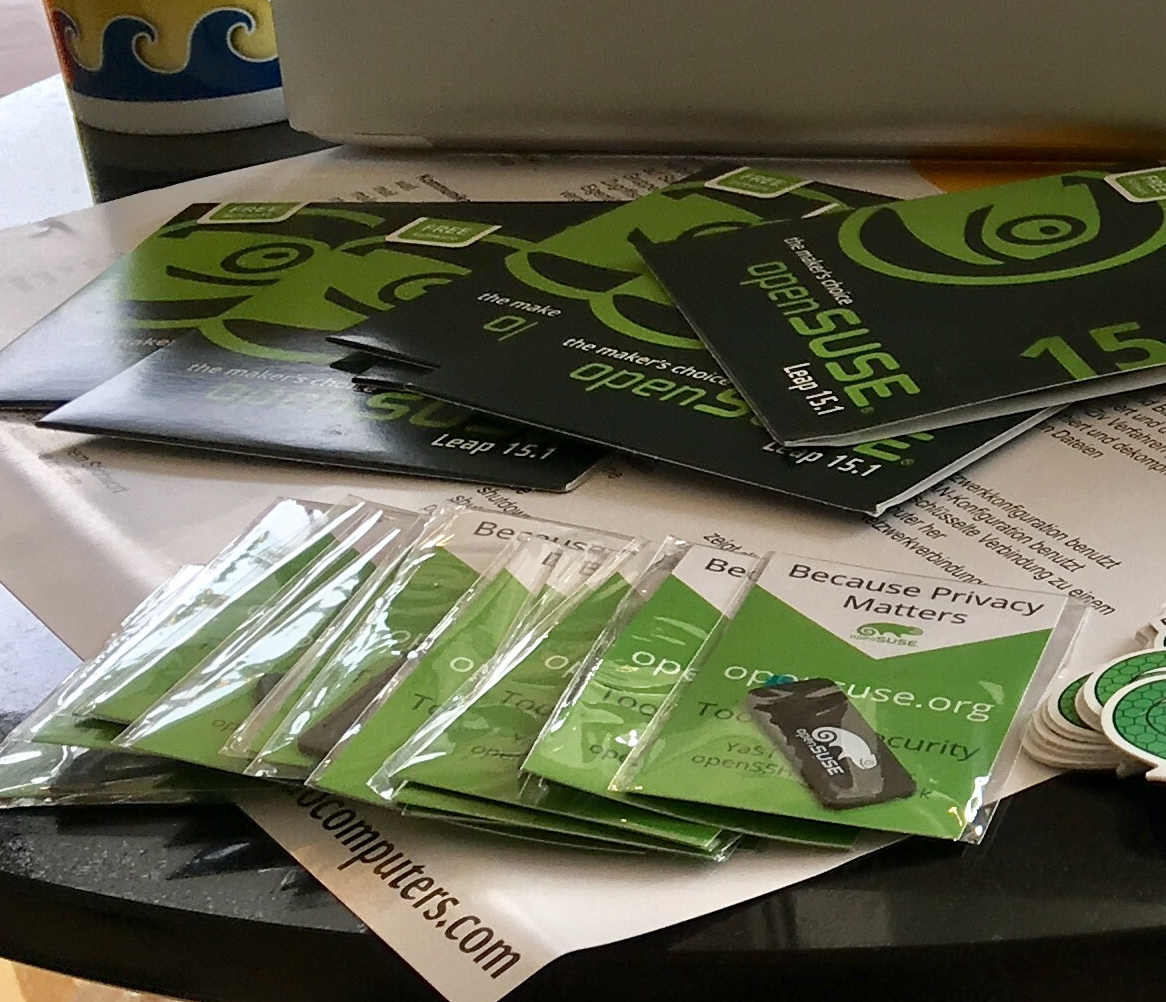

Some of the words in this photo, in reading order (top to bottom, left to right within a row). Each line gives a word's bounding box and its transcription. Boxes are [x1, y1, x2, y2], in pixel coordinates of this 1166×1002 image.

[421, 223, 474, 236] FREE
[478, 292, 511, 306] the
[508, 298, 562, 318] make
[740, 261, 920, 408] openSUSE
[186, 361, 222, 376] the
[562, 336, 597, 352] the
[595, 344, 671, 371] maker's
[783, 362, 819, 391] Leap
[805, 390, 845, 416] 15.1
[1132, 413, 1166, 428] und
[431, 433, 495, 455] Leap
[501, 442, 556, 460] 15.1
[1051, 429, 1104, 459] Dateien
[1087, 428, 1120, 445] und
[827, 454, 882, 478] 15.1
[917, 521, 948, 541] her
[950, 474, 1069, 543] zwerkkonfiguration
[1065, 537, 1123, 571] benutzt
[978, 532, 1054, 582] Verbindung
[1047, 575, 1073, 596] zu
[1029, 541, 1087, 574] benutzt
[788, 563, 922, 599] Because
[930, 586, 1045, 617] Privacy
[842, 594, 968, 625] Matters
[795, 728, 845, 776] openSUSE
[296, 788, 521, 980] ocomputers.com
